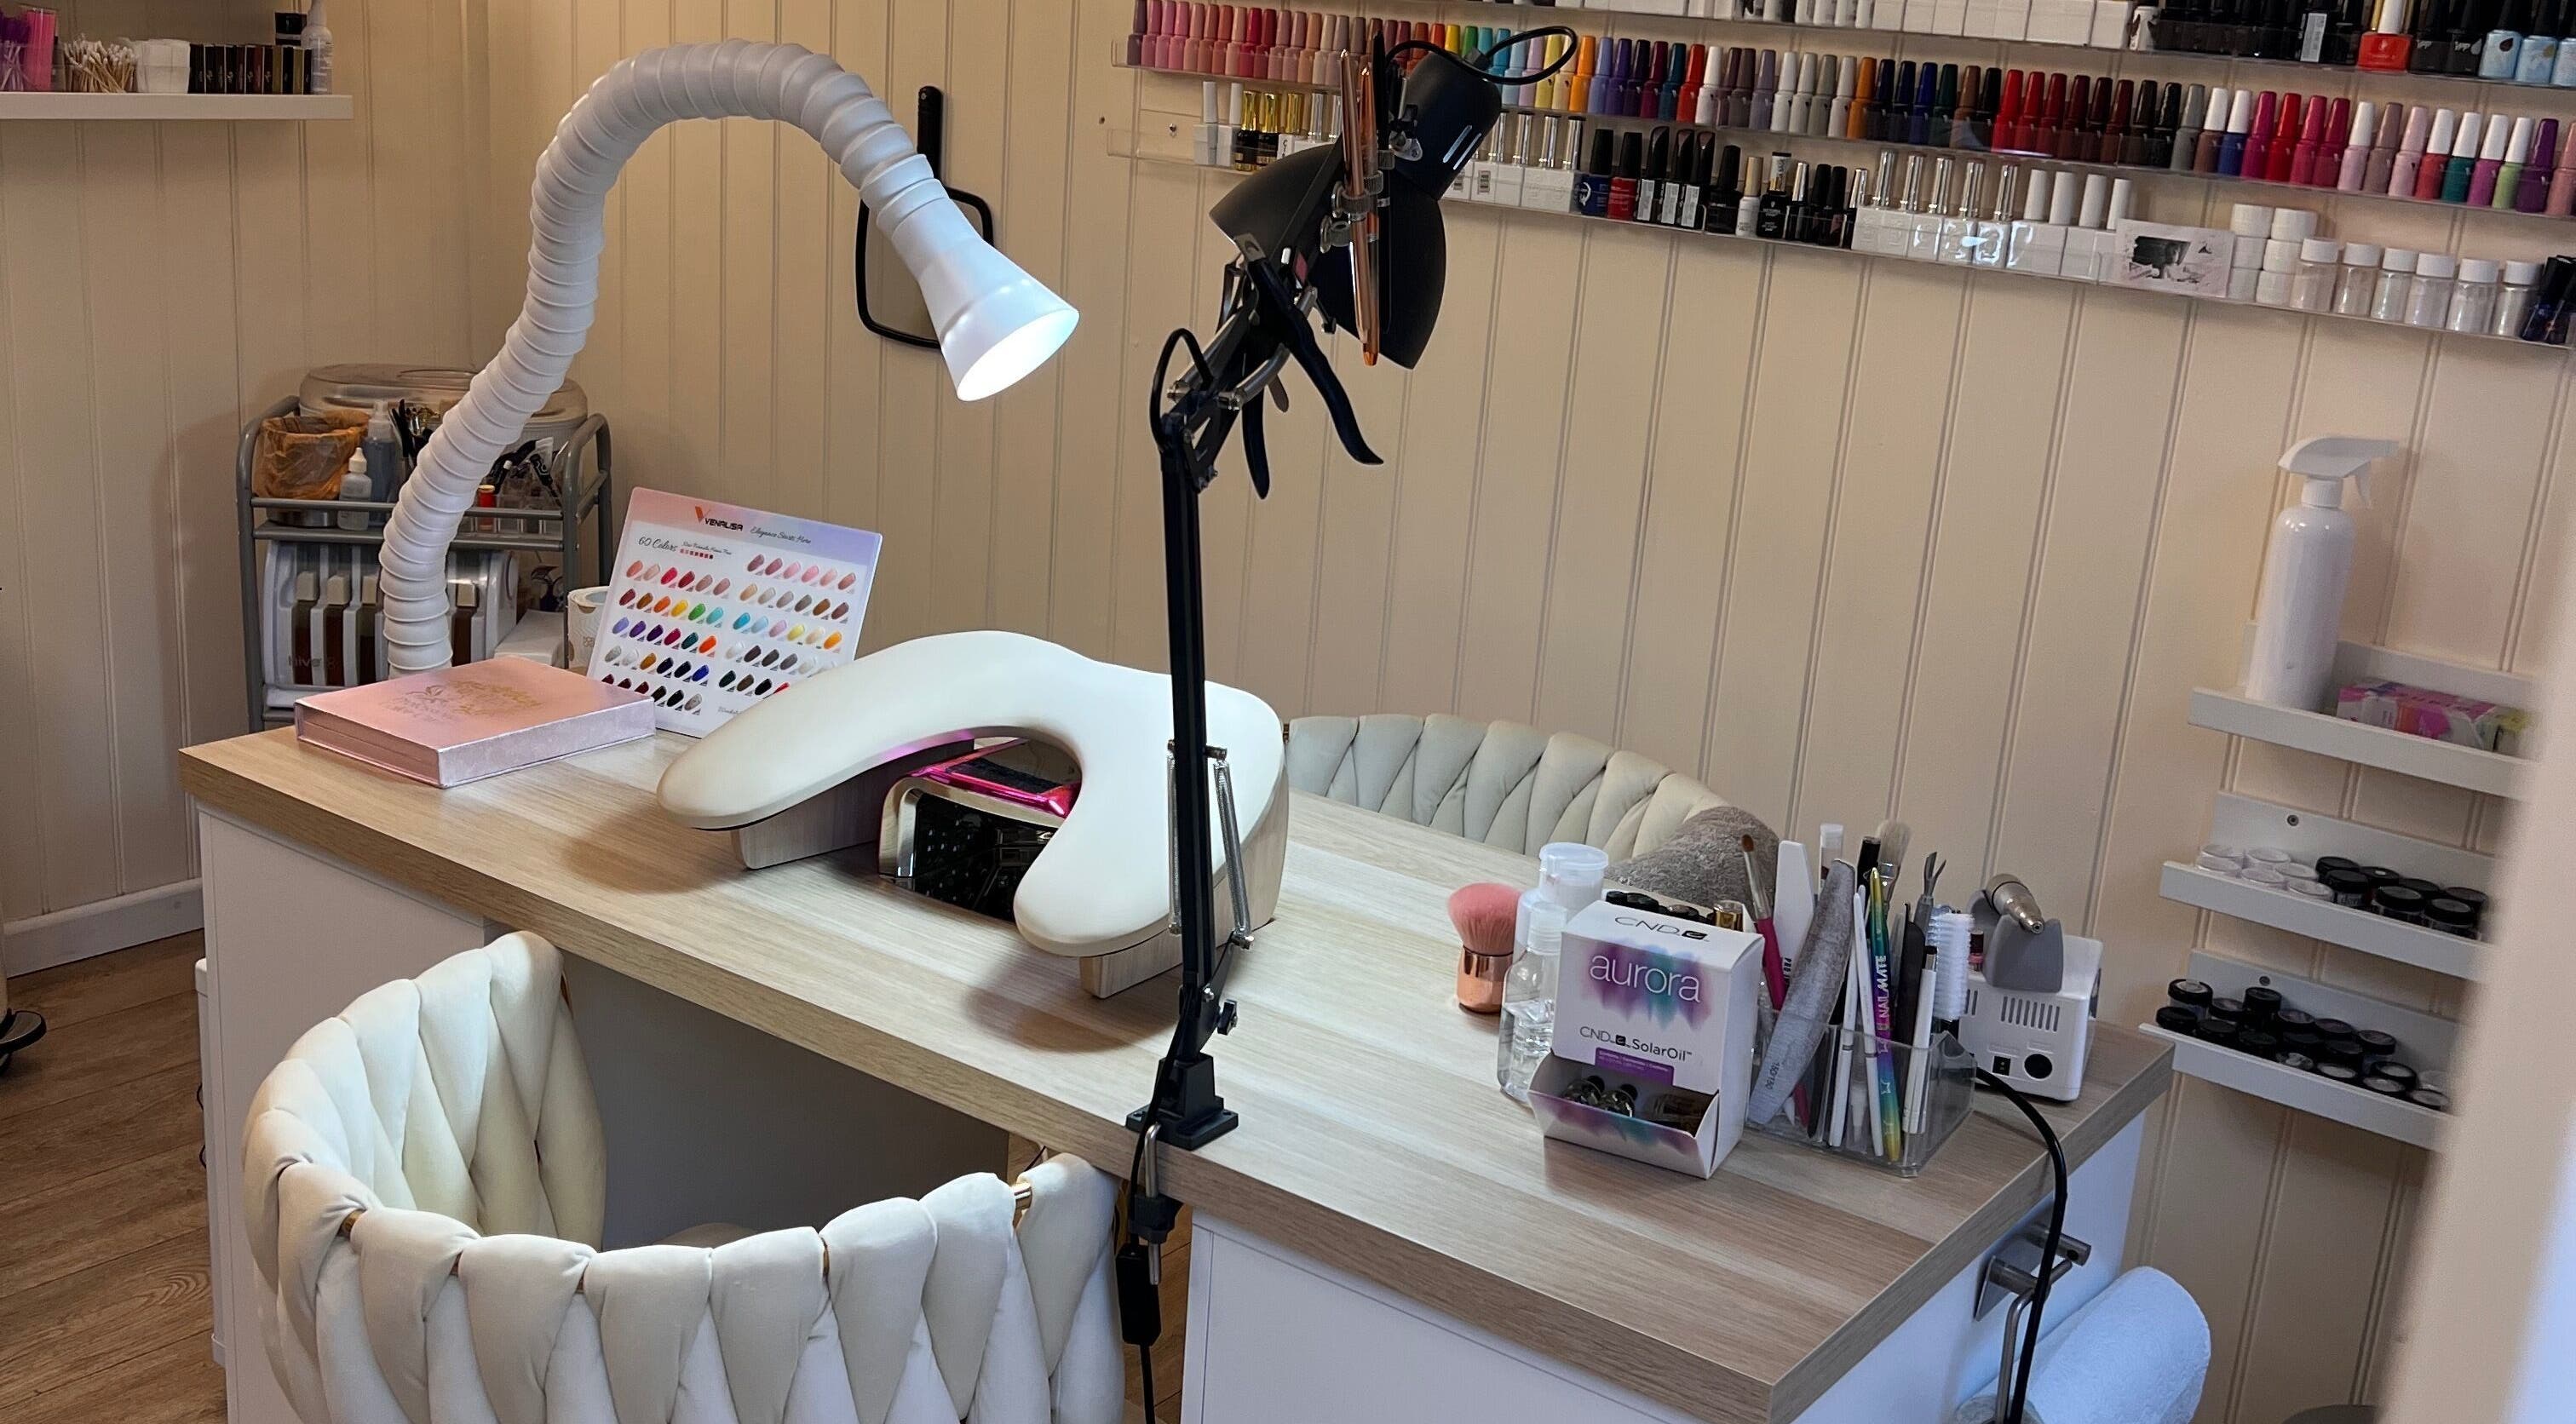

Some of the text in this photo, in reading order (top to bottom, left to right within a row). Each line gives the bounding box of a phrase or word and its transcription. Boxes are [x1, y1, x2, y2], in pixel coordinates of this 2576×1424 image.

[639, 536, 650, 547] 60
[652, 537, 678, 552] Colors
[1615, 916, 1680, 934] CND
[1590, 955, 1701, 1002] aurora
[1579, 1025, 1612, 1042] CND
